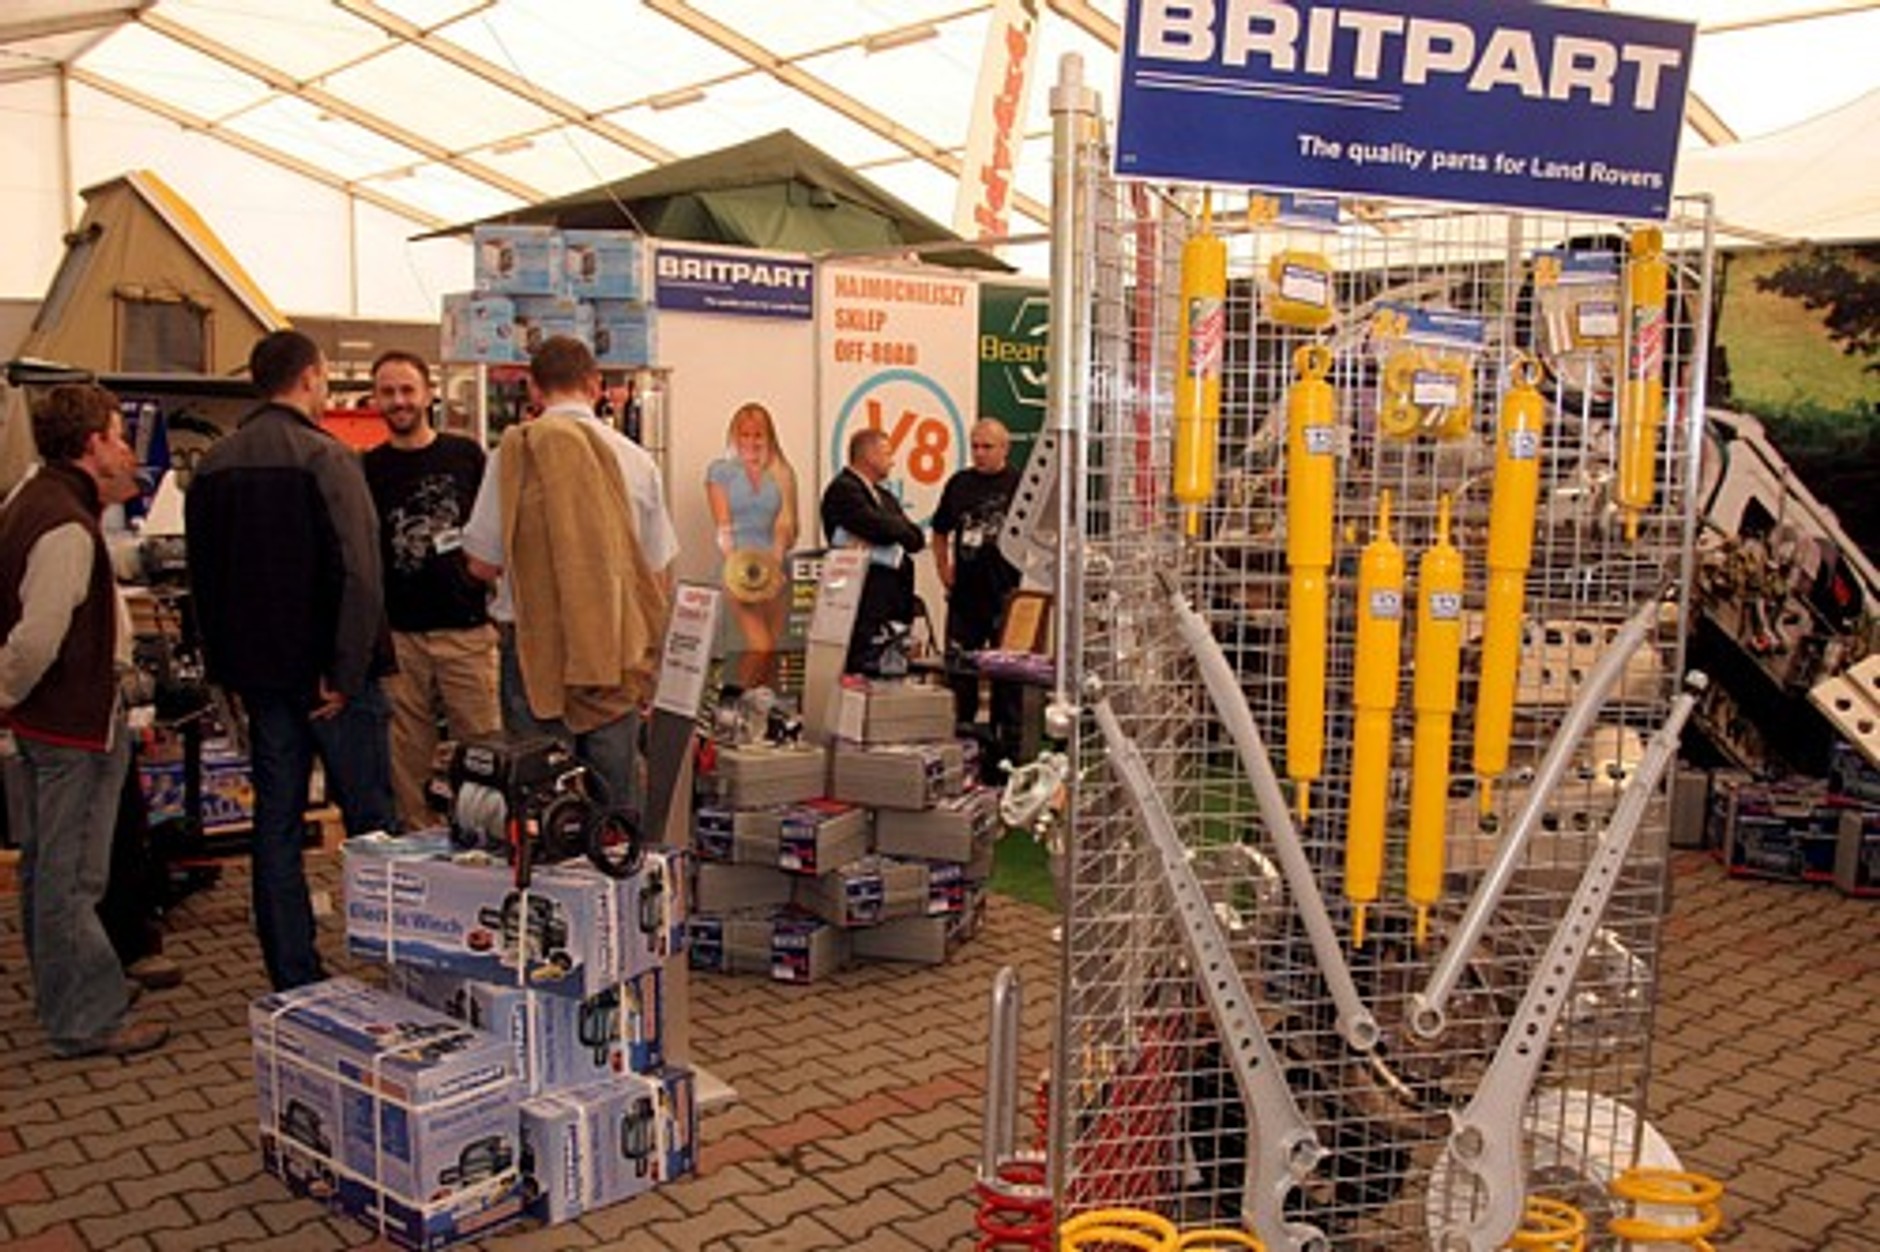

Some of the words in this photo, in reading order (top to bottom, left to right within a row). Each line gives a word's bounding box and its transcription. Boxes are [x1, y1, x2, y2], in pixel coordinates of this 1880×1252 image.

[1137, 0, 1681, 111] BRITPART
[1297, 134, 1342, 160] The
[1347, 142, 1427, 171] quality
[1431, 150, 1488, 172] parts
[1494, 152, 1527, 175] for
[1530, 157, 1585, 181] Land
[1589, 161, 1664, 188] Rovers
[657, 255, 811, 288] BRITPART
[834, 308, 888, 332] SKLEP
[834, 338, 918, 366] OFF-ROAD
